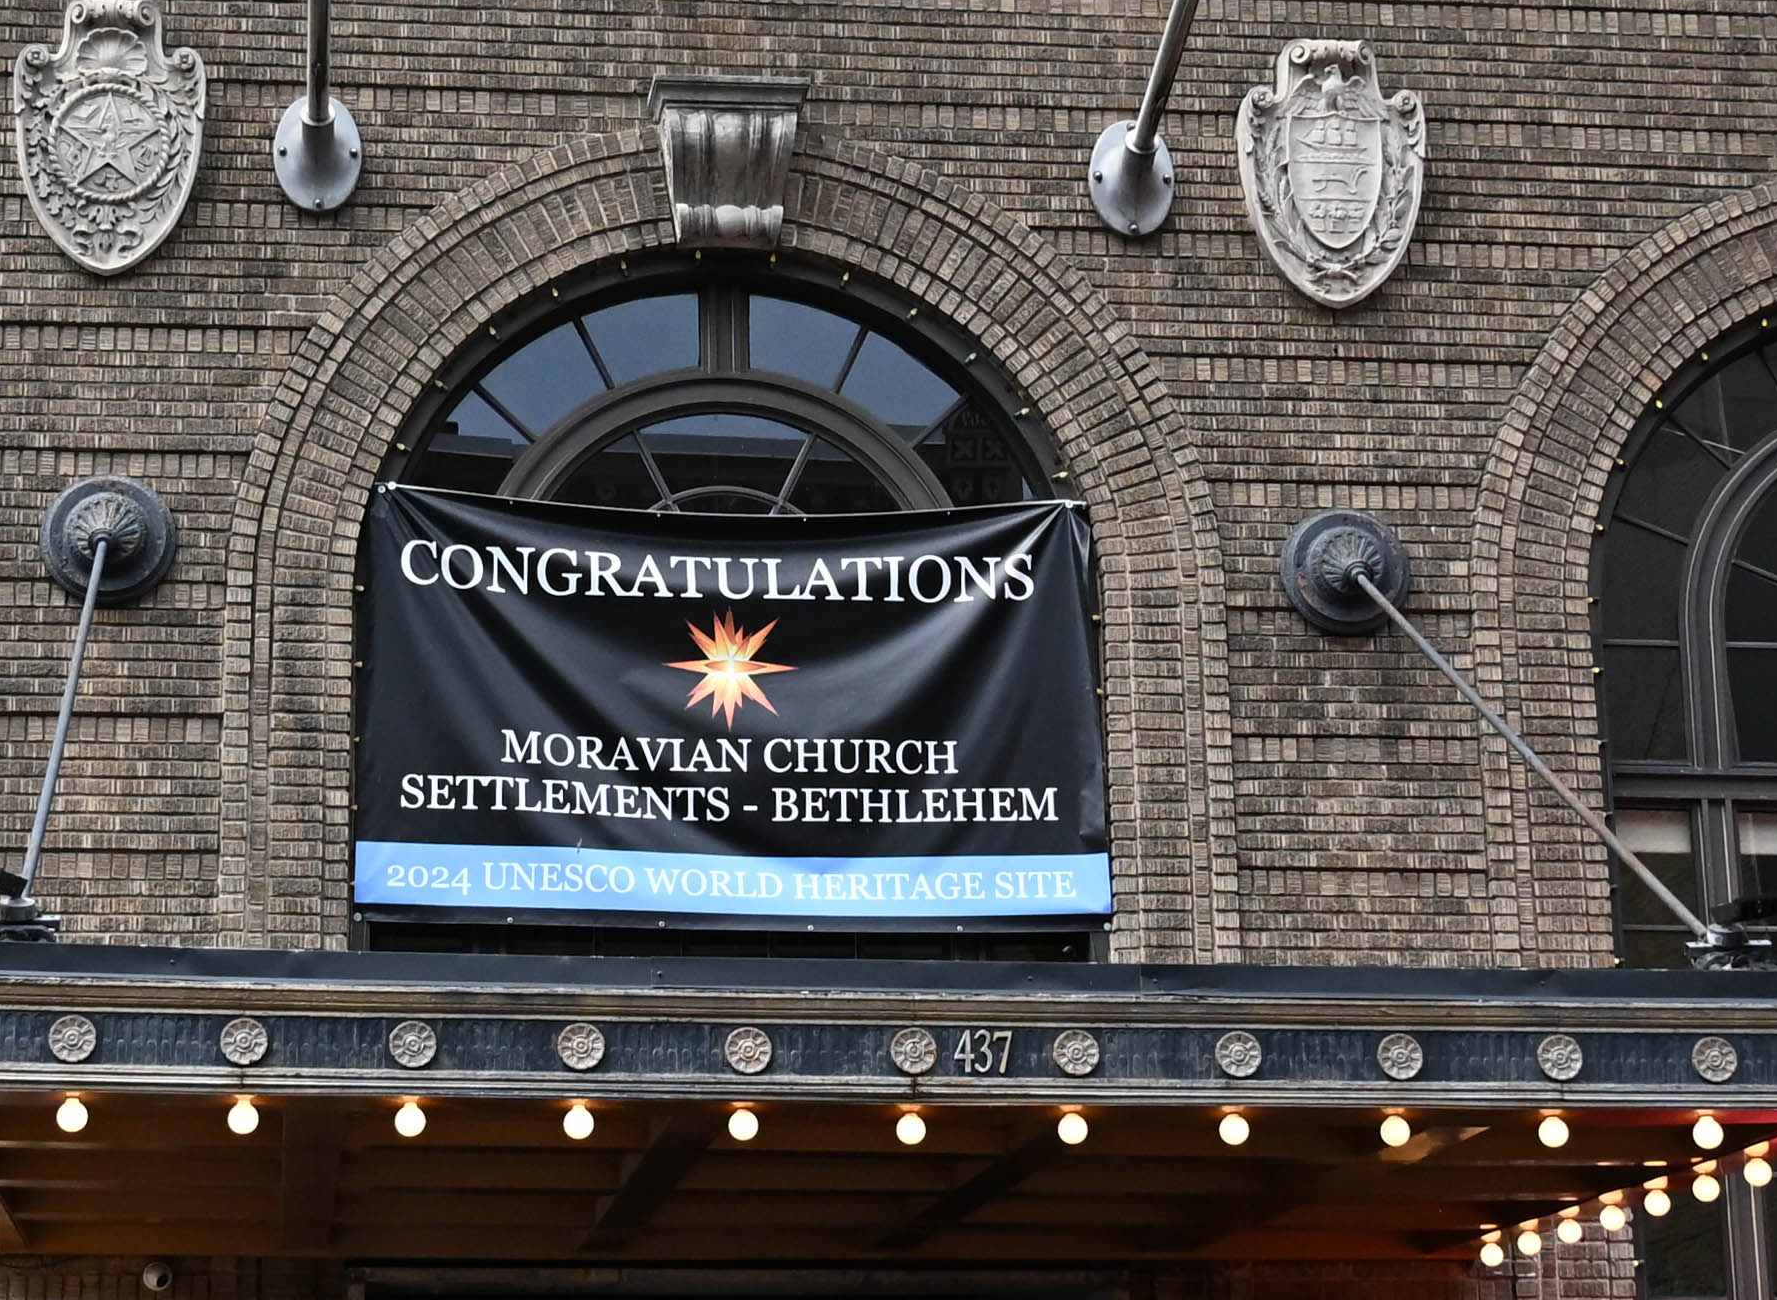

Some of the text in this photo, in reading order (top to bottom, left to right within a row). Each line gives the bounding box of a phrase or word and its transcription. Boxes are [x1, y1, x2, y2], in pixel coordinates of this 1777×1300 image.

[399, 539, 1035, 603] CONGRATULATIONS
[500, 728, 958, 775] MORAVIAN CHURCH
[399, 773, 730, 821] SETTLEMENTS
[772, 785, 1059, 823] BETHLEHEM
[387, 861, 1076, 901] 2024 UNESCO WORLD HERITAGE SITE
[953, 1028, 1013, 1074] 437
